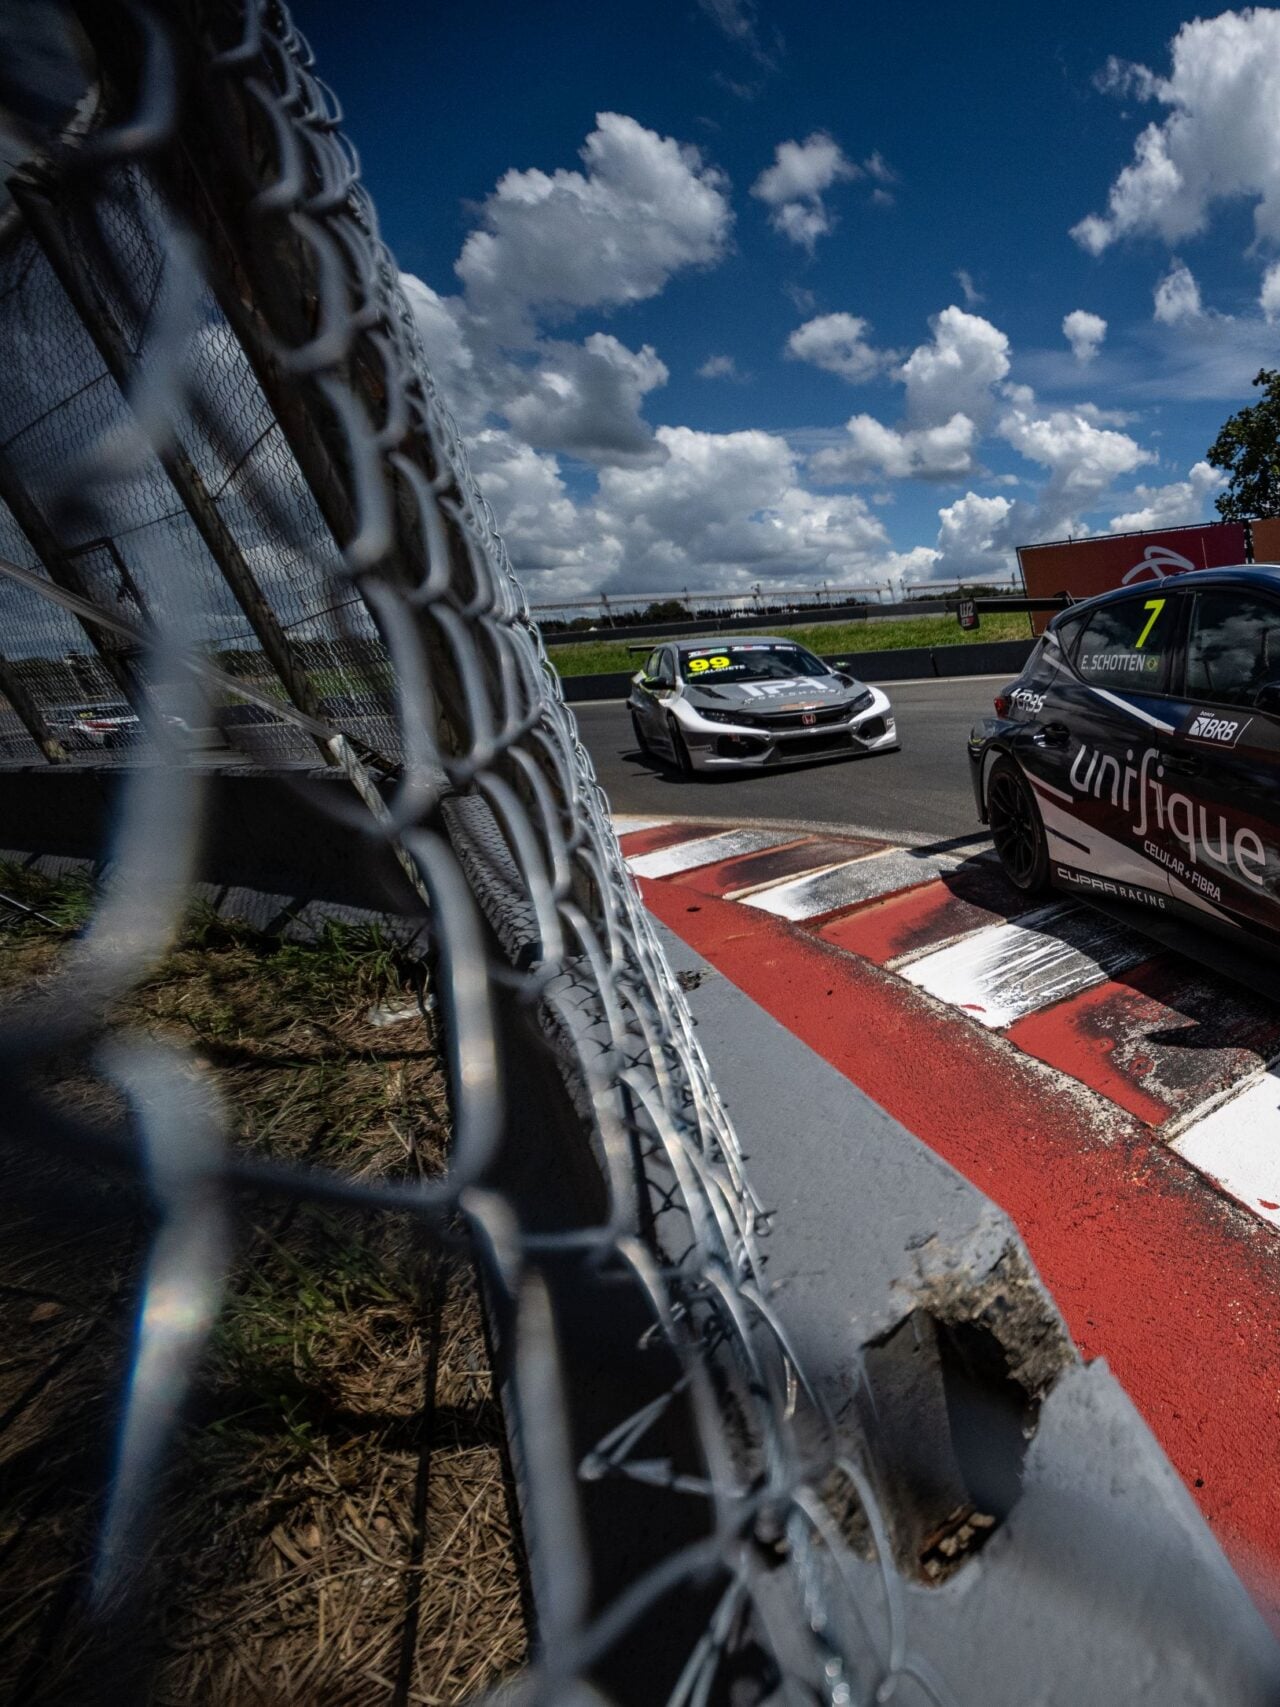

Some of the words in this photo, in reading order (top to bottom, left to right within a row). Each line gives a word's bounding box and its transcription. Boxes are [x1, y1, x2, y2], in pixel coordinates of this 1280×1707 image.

[1135, 598, 1166, 648] 7
[688, 656, 731, 673] 99
[1090, 654, 1146, 672] SCHOTTEN
[1203, 719, 1238, 741] BRB
[1069, 744, 1266, 886] unifique
[1057, 867, 1118, 894] CUPRA
[1120, 887, 1165, 909] RACING
[1143, 839, 1185, 878] CELULAR
[1191, 870, 1221, 902] FIBRA
